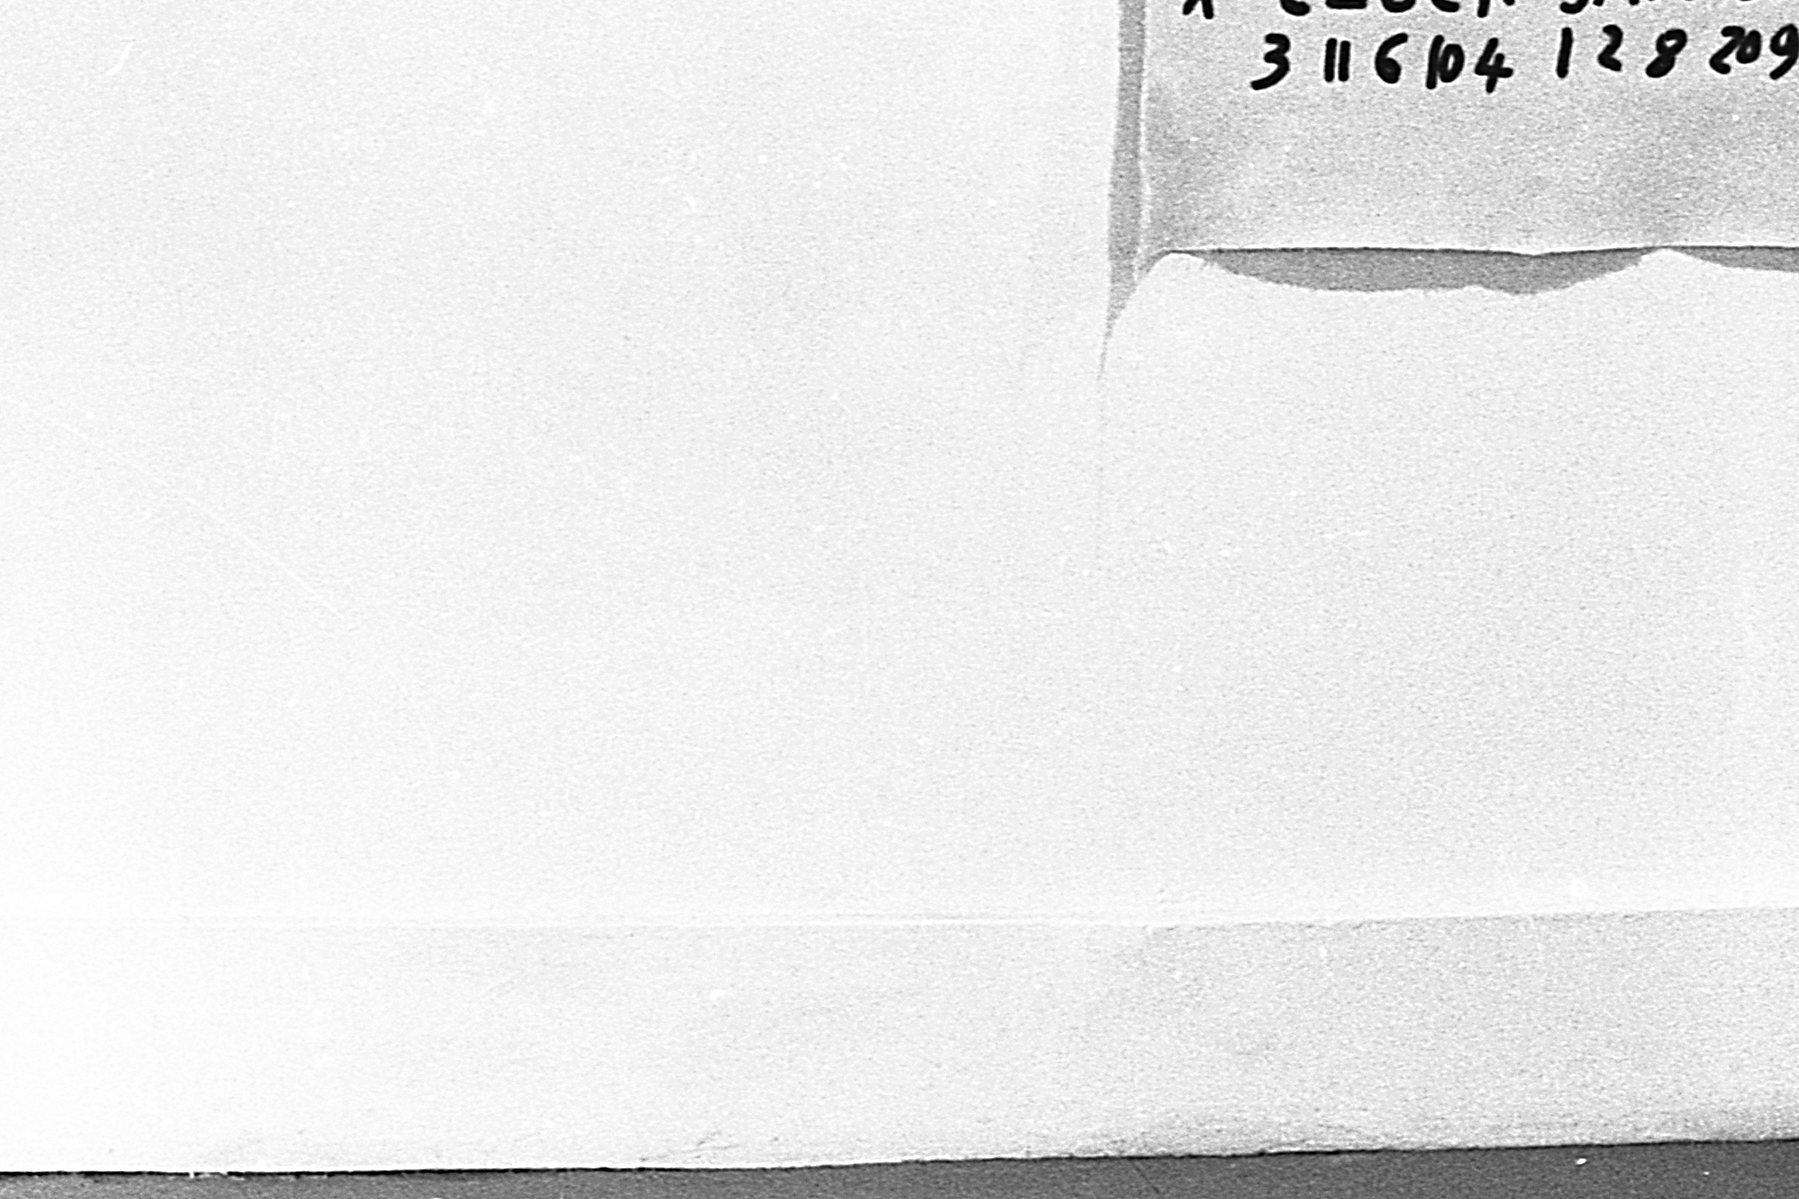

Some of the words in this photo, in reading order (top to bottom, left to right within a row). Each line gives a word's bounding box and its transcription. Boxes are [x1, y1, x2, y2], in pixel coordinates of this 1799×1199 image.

[1250, 32, 1291, 91] 3
[1374, 32, 1409, 84] 6
[1556, 26, 1574, 79] 1
[1597, 24, 1624, 72] 2
[1645, 28, 1688, 79] 8
